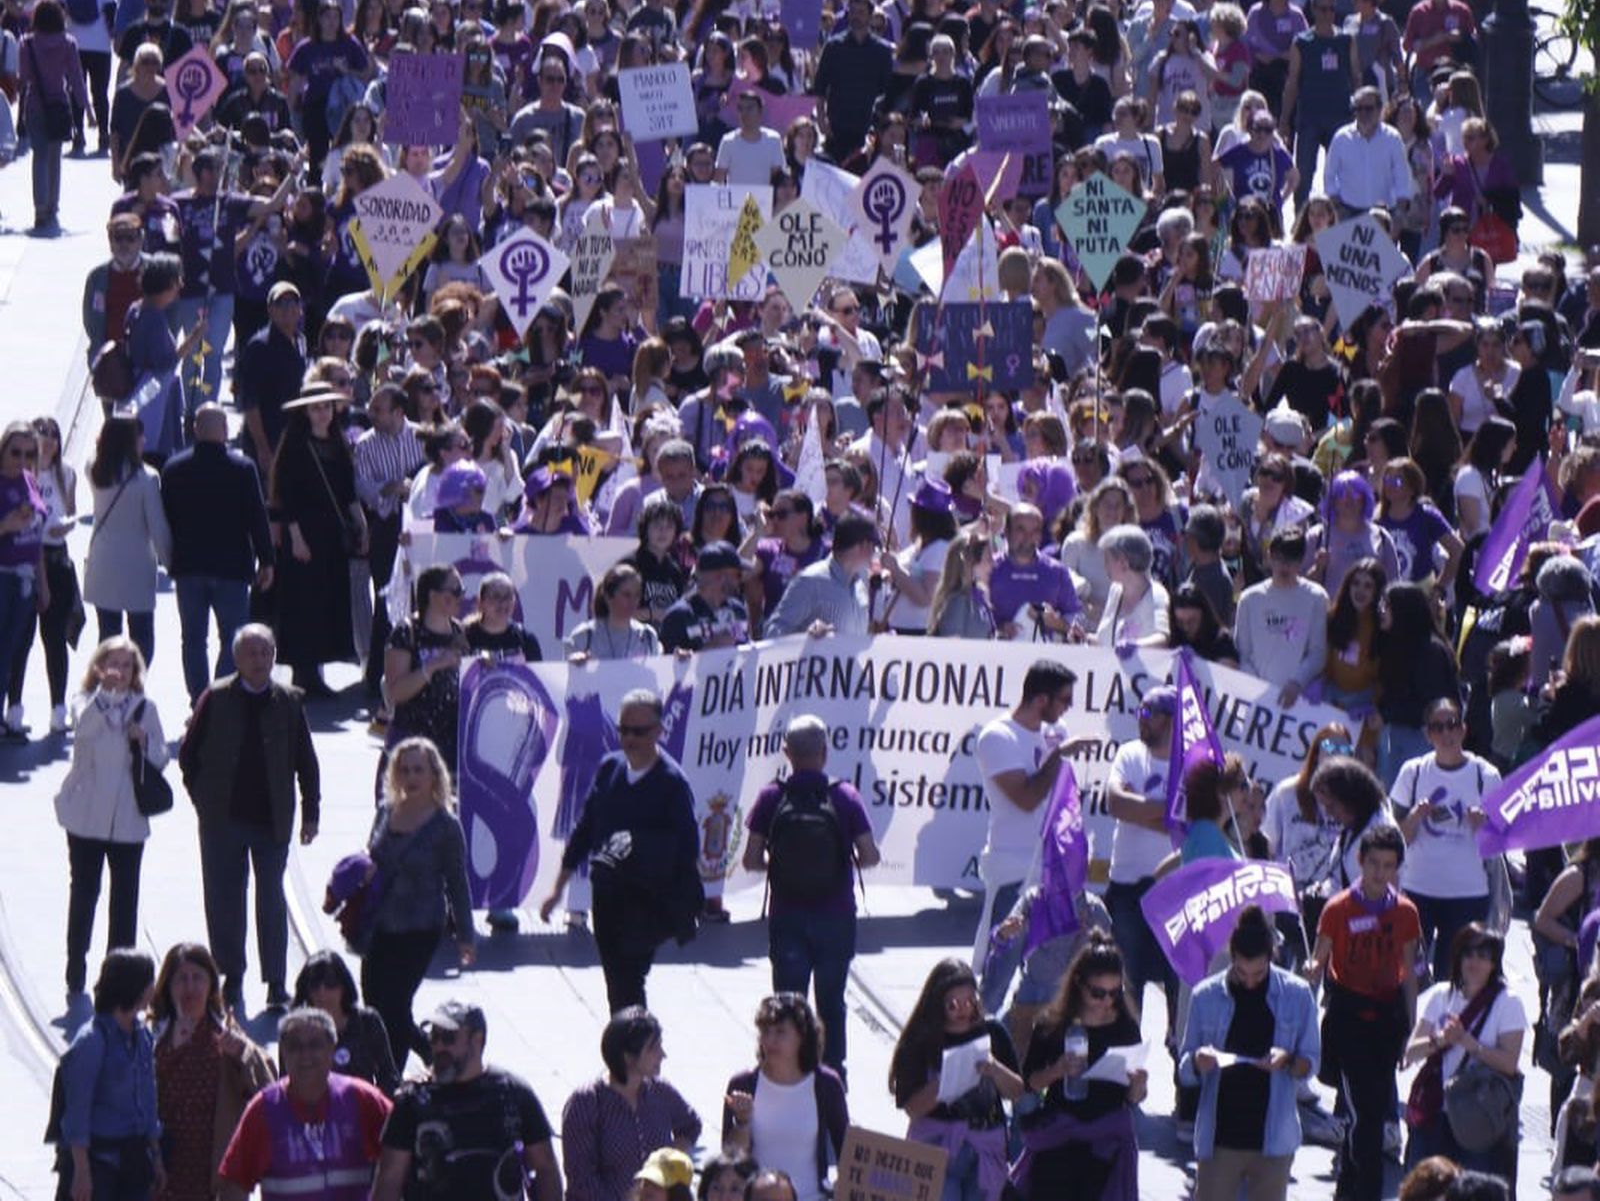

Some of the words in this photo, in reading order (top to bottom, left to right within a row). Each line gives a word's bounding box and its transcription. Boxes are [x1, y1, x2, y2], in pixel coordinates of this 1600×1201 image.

[1086, 180, 1104, 196] NI
[358, 199, 431, 223] SORORIDAD
[1073, 199, 1135, 216] SANTA
[780, 213, 823, 233] OLE
[1087, 219, 1108, 234] NI
[1076, 237, 1120, 254] PUTA
[1352, 224, 1375, 246] NI
[1340, 244, 1380, 273] UNA
[1326, 264, 1382, 295] MENOS
[701, 660, 744, 717] DÍA
[754, 655, 1009, 709] INTERNACIONAL
[697, 731, 741, 769] Hoy
[748, 720, 785, 758] má
[871, 769, 990, 812] sistem
